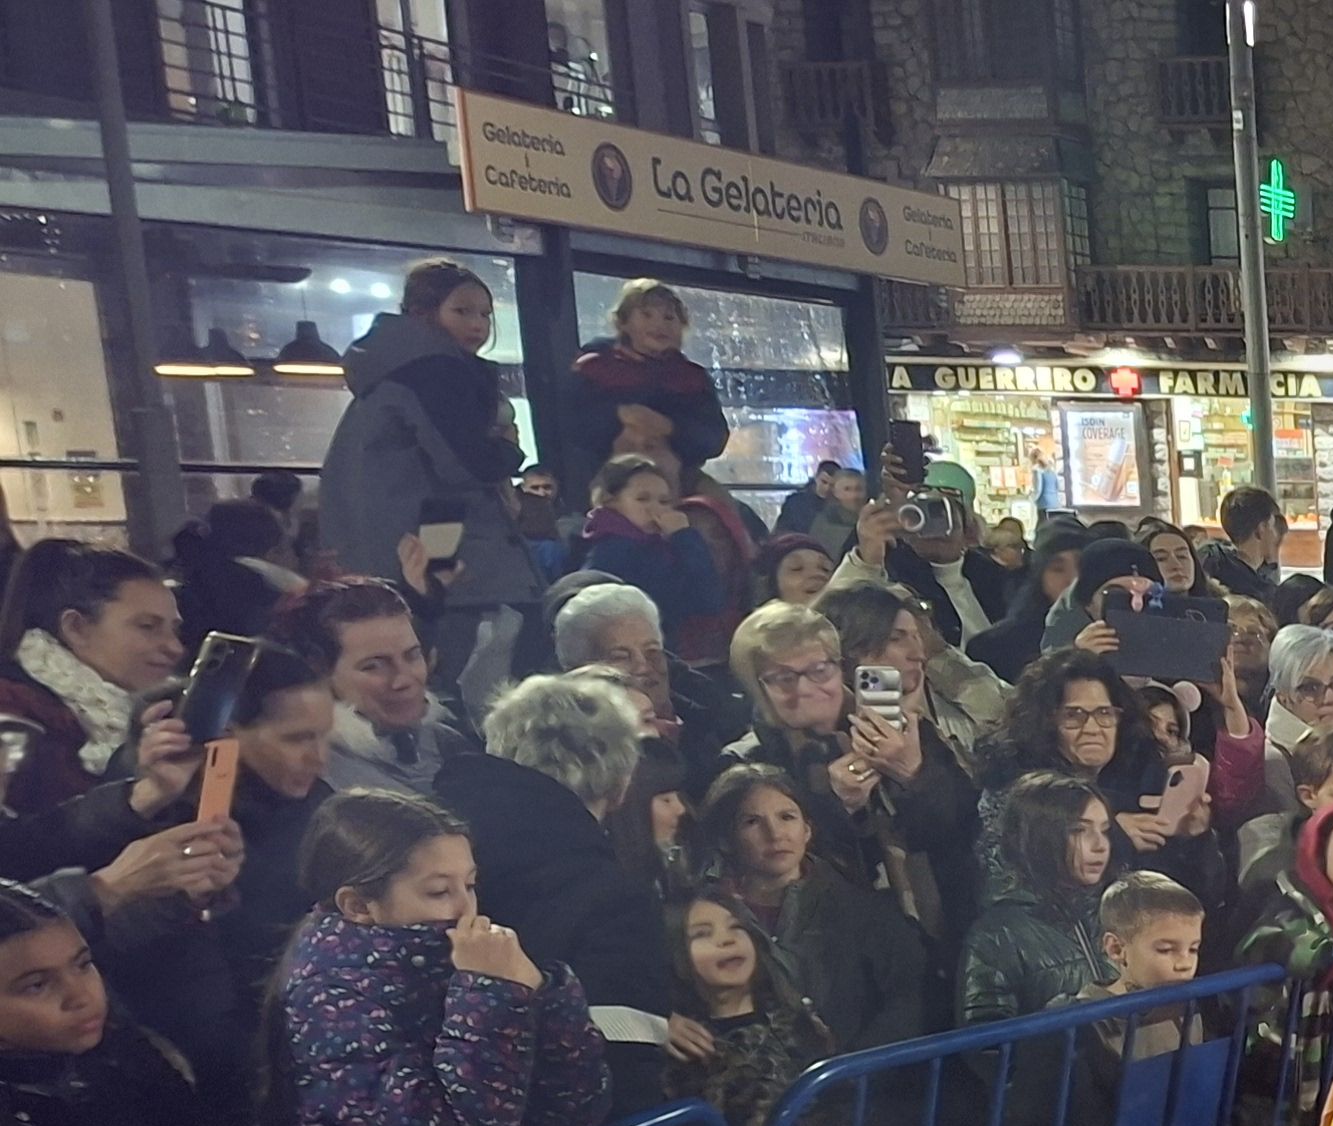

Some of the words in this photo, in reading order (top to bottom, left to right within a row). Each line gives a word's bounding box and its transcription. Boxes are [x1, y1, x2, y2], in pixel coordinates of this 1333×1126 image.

[482, 121, 565, 156] Gelateria
[485, 165, 571, 198] Cafeteria
[652, 157, 694, 203] La
[701, 167, 843, 231] Gelateria
[903, 205, 954, 231] Gelateria
[935, 367, 1096, 391] GUERRERO
[1159, 371, 1322, 397] FARMCIA
[1082, 427, 1126, 440] COVERAGE
